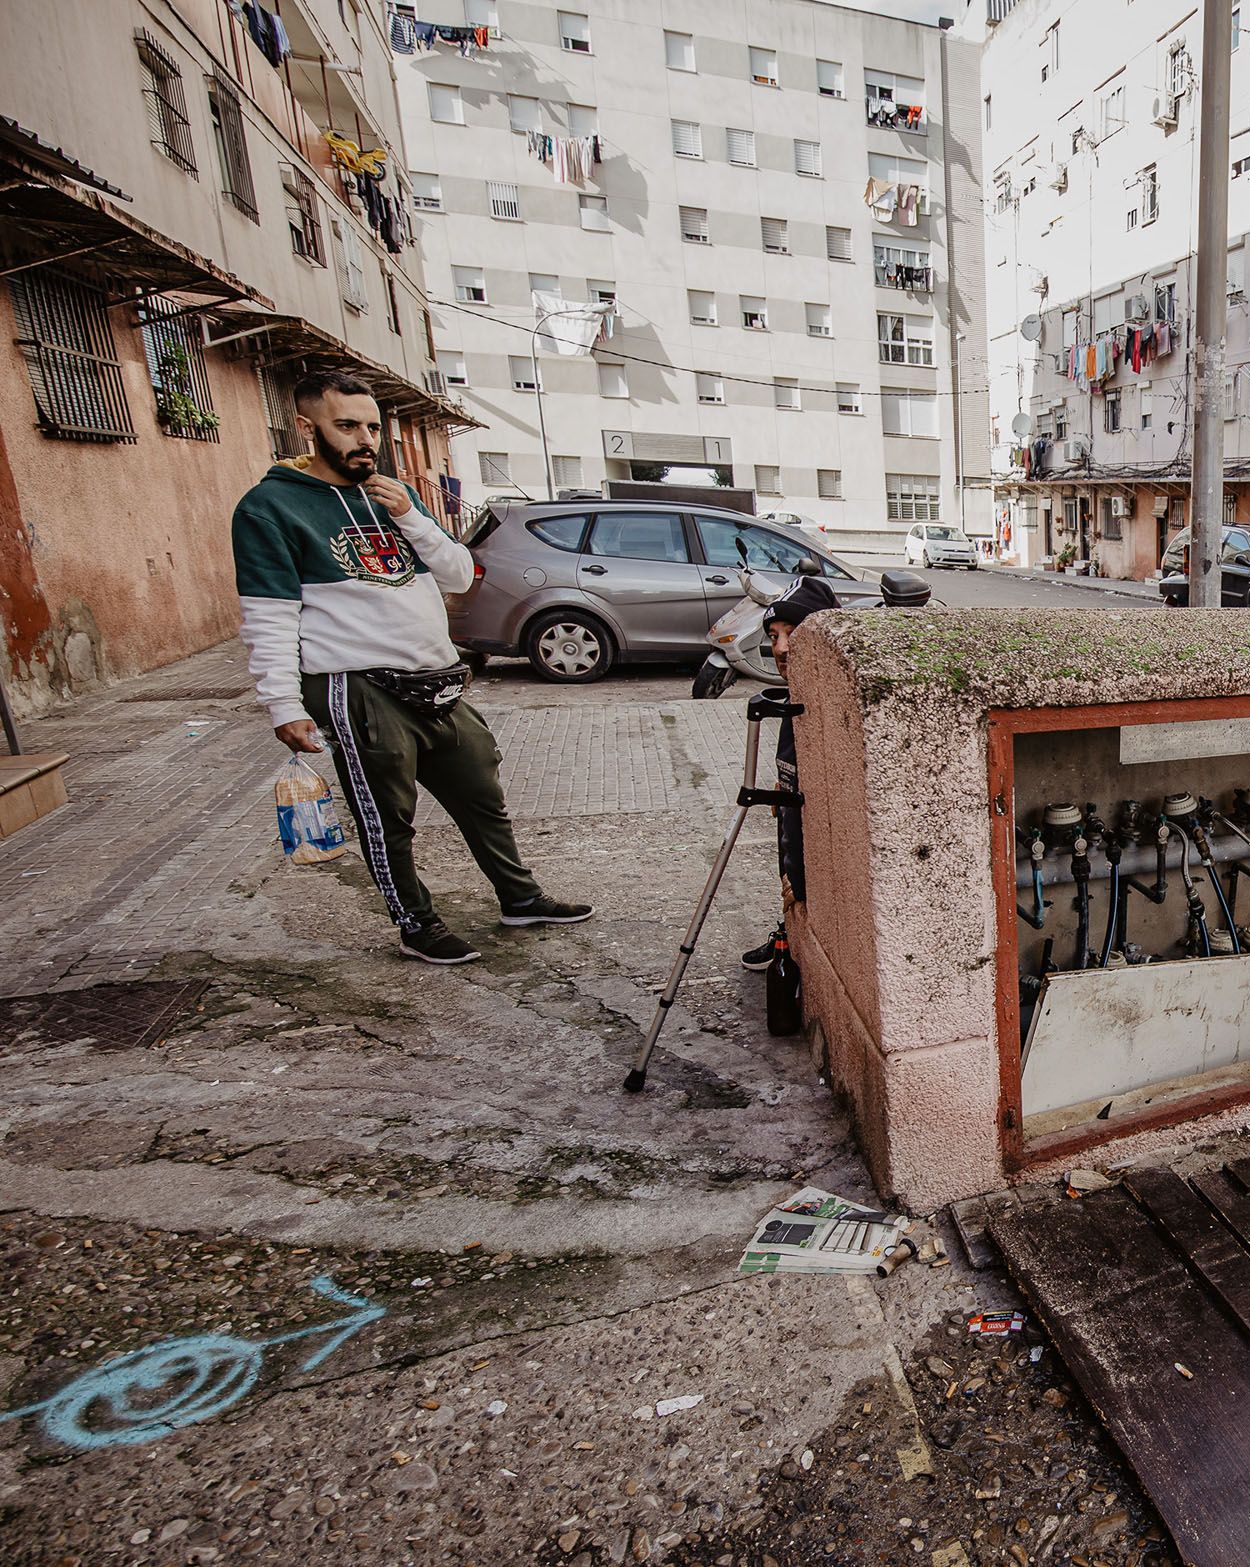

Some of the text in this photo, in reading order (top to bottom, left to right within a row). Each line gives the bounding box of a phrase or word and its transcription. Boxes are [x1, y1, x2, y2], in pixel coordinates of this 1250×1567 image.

[611, 435, 625, 454] 2
[714, 441, 722, 459] 1
[440, 684, 464, 696] NIKE
